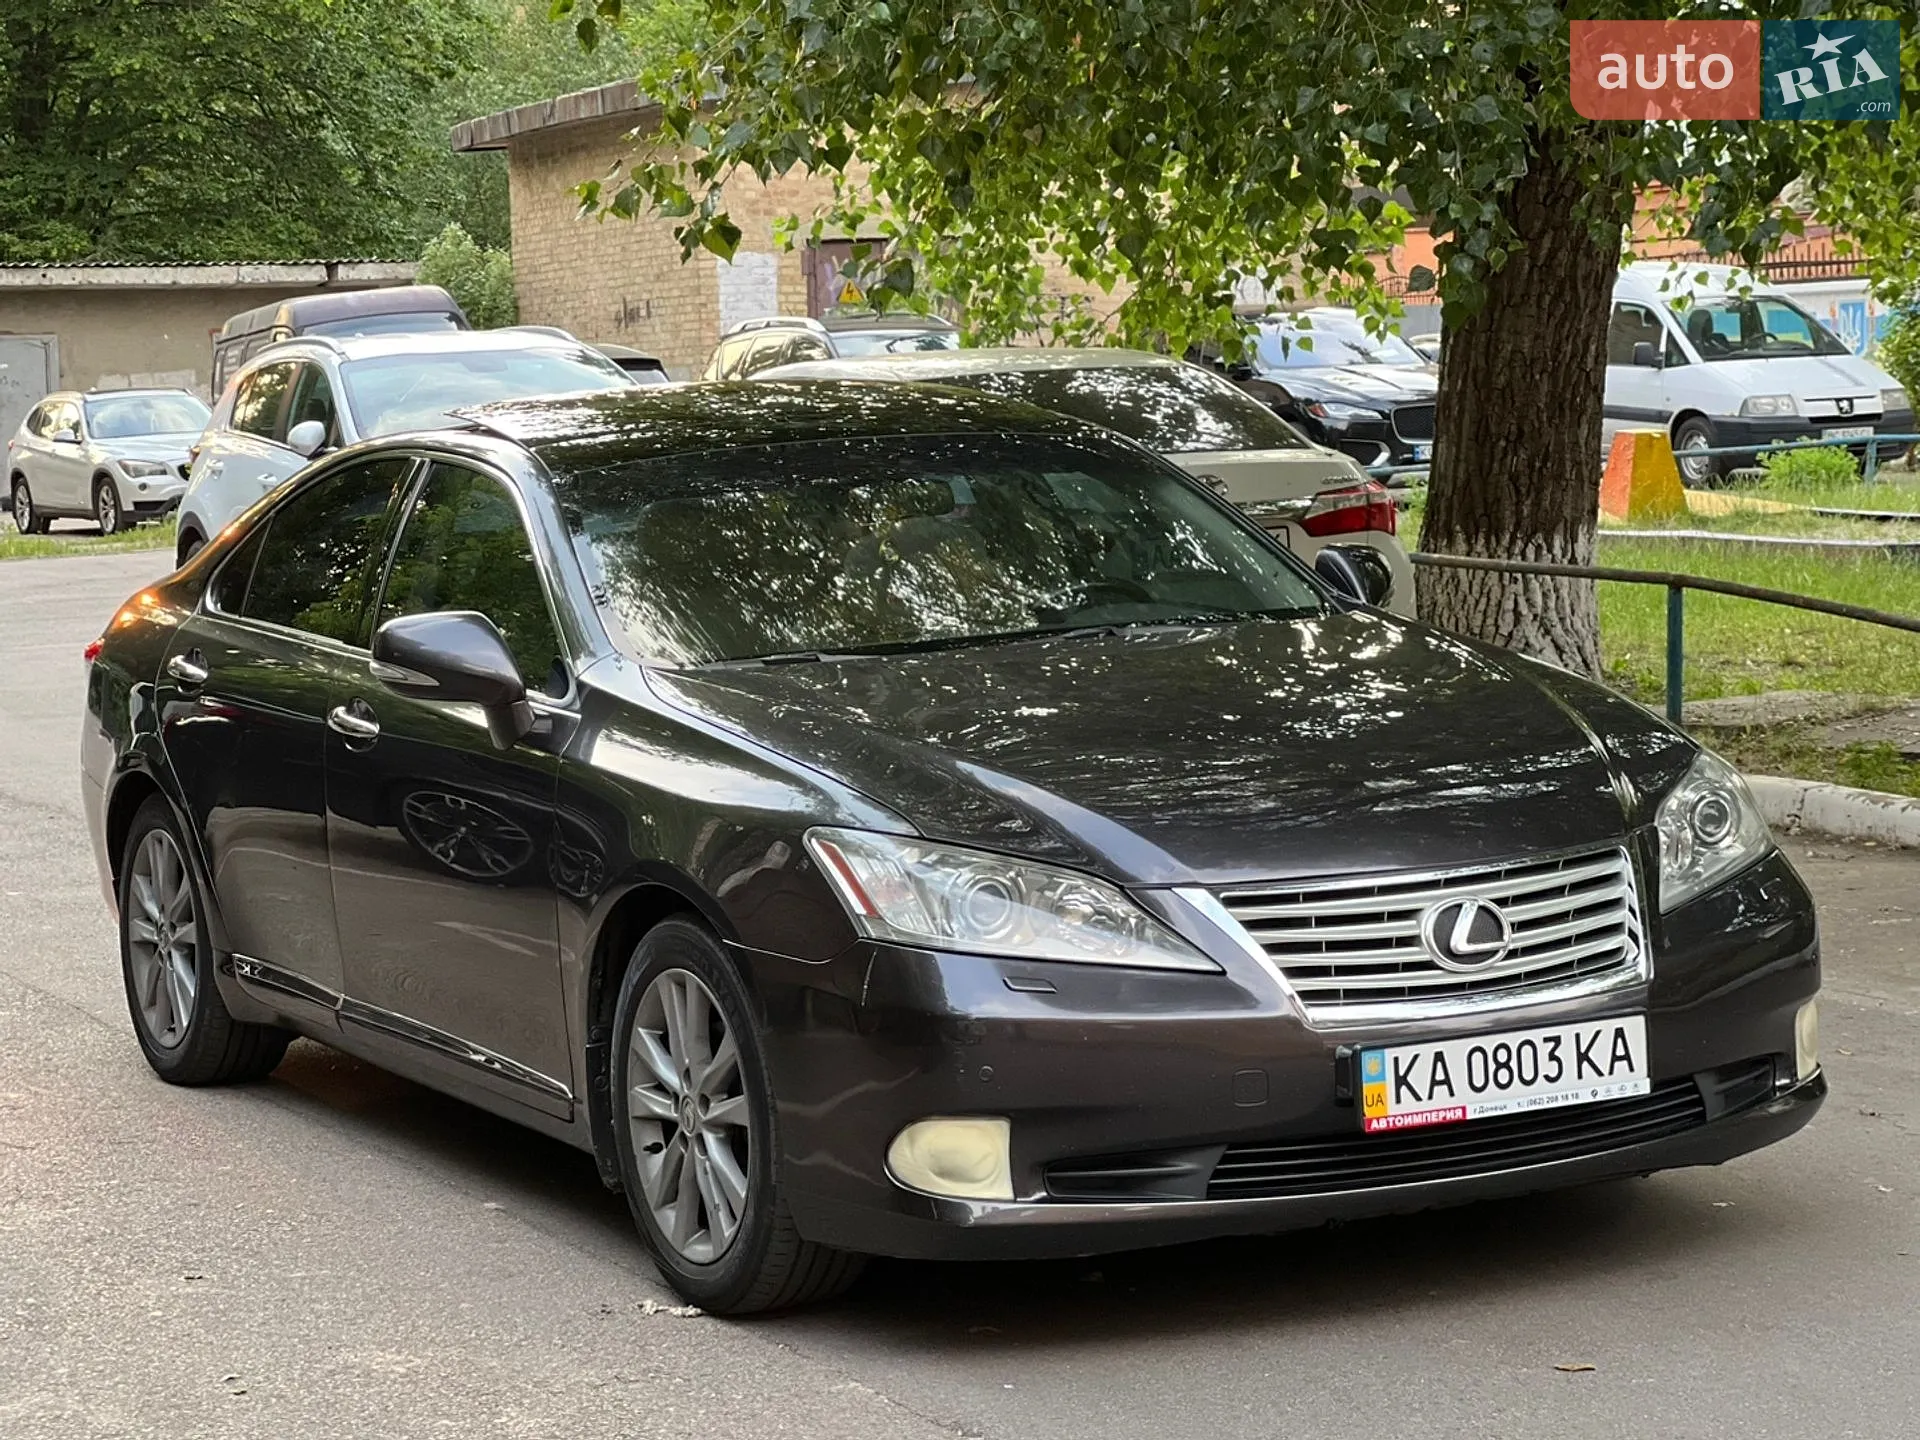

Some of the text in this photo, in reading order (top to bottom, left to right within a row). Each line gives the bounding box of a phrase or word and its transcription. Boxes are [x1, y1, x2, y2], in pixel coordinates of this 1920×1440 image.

[1393, 1026, 1635, 1105] KA 0803 KA
[1364, 1093, 1384, 1108] UA
[1370, 1108, 1463, 1130] АВТОИМПЕРИЯ
